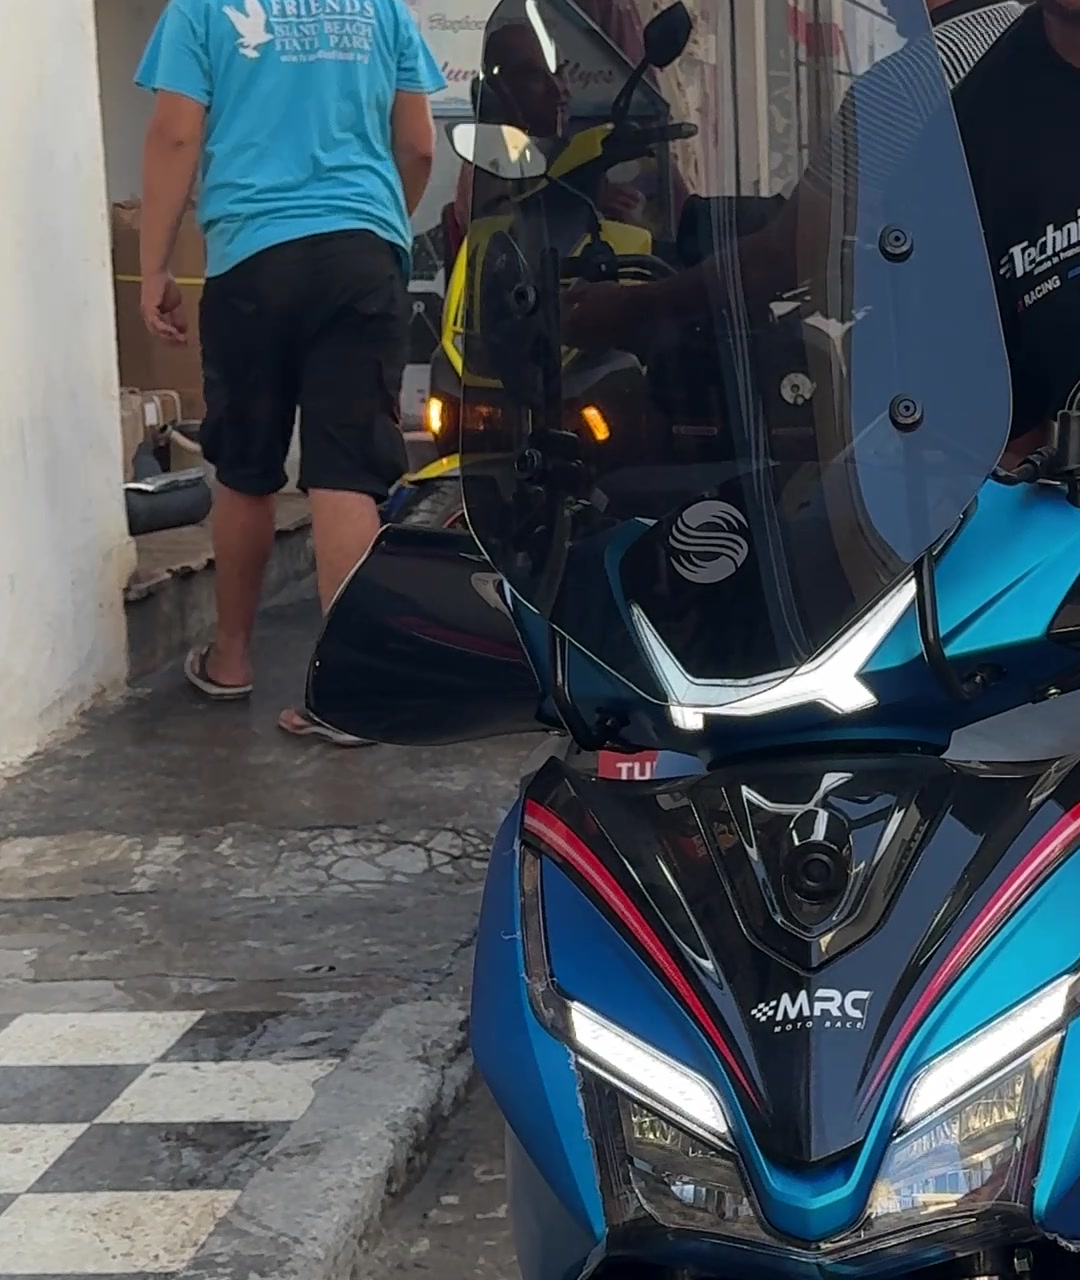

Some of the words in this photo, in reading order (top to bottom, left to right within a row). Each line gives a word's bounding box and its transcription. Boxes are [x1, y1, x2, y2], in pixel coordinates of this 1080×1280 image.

[322, 20, 373, 38] BEACH
[328, 34, 372, 51] PARK
[1023, 275, 1062, 308] RACING
[776, 988, 872, 1022] MRC
[773, 1020, 814, 1033] MOTO
[824, 1020, 865, 1031] RACE
